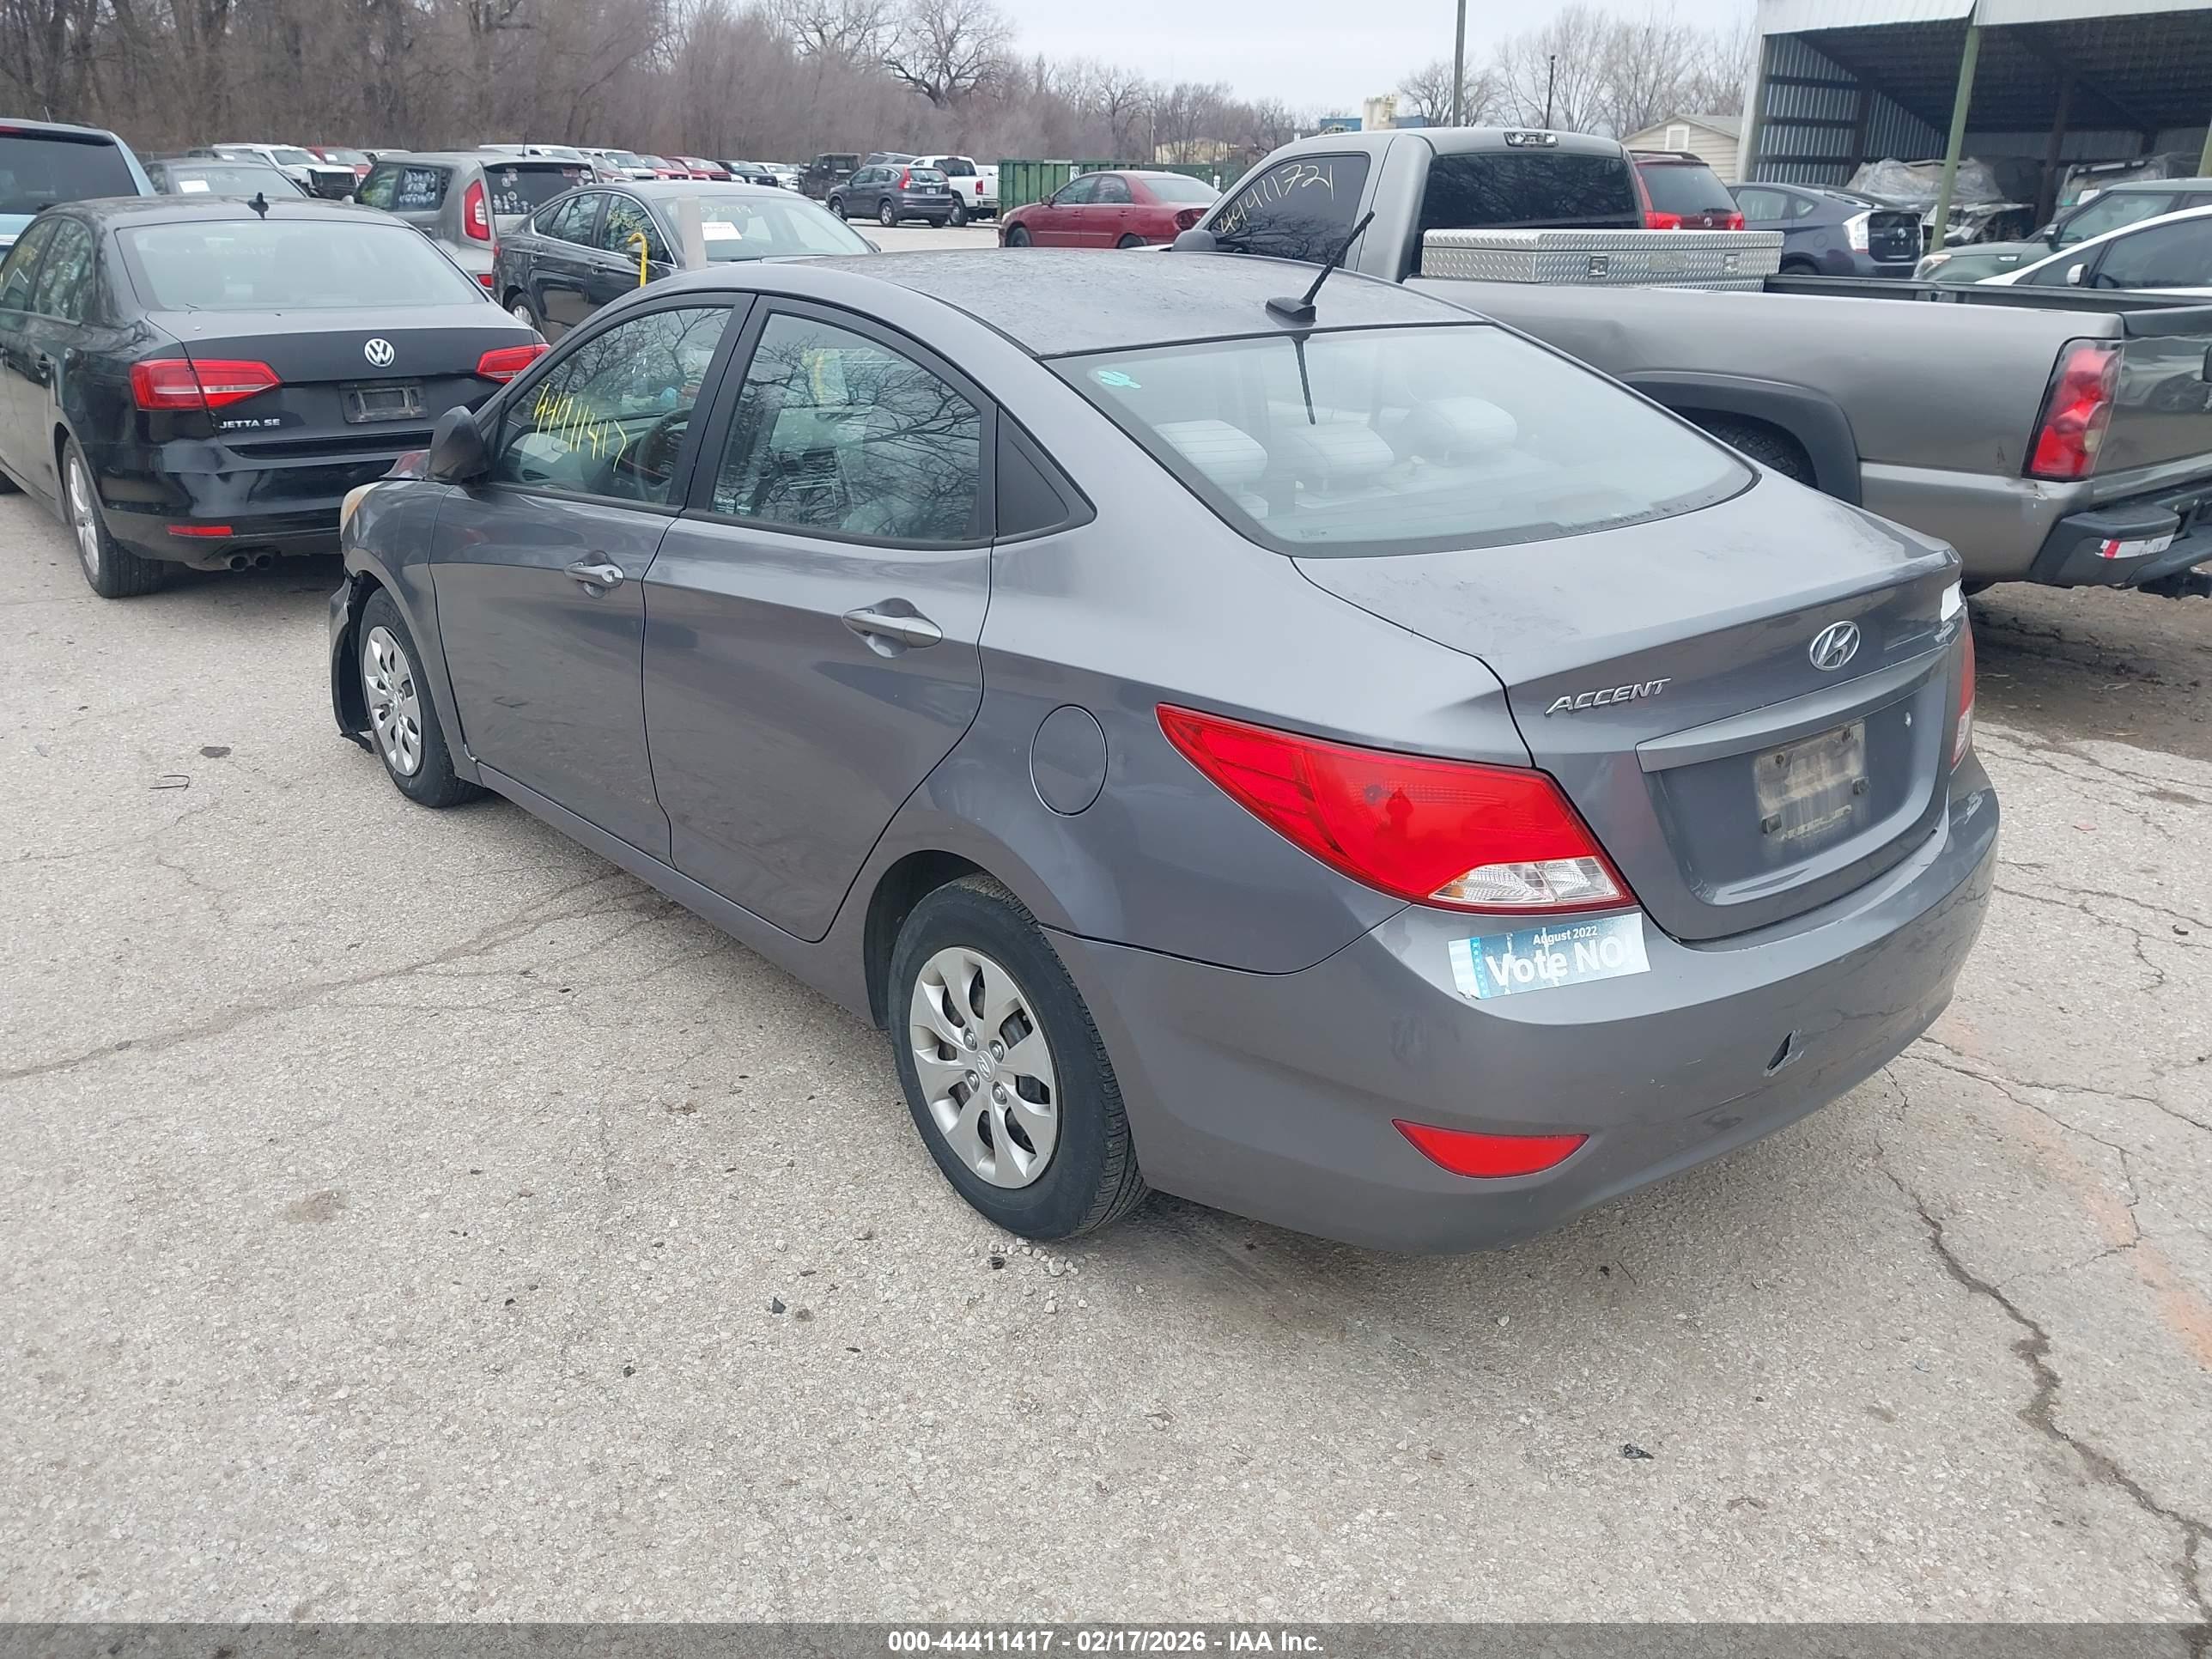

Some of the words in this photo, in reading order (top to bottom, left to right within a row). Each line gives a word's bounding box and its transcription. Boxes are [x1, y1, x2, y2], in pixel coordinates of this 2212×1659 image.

[1219, 164, 1334, 234] 44411721
[219, 419, 260, 429] JETTA
[264, 418, 281, 427] SE
[1545, 678, 1672, 714] ACCENT
[1533, 930, 1571, 946] August
[1572, 925, 1598, 939] 2022
[1485, 948, 1569, 988] Vote
